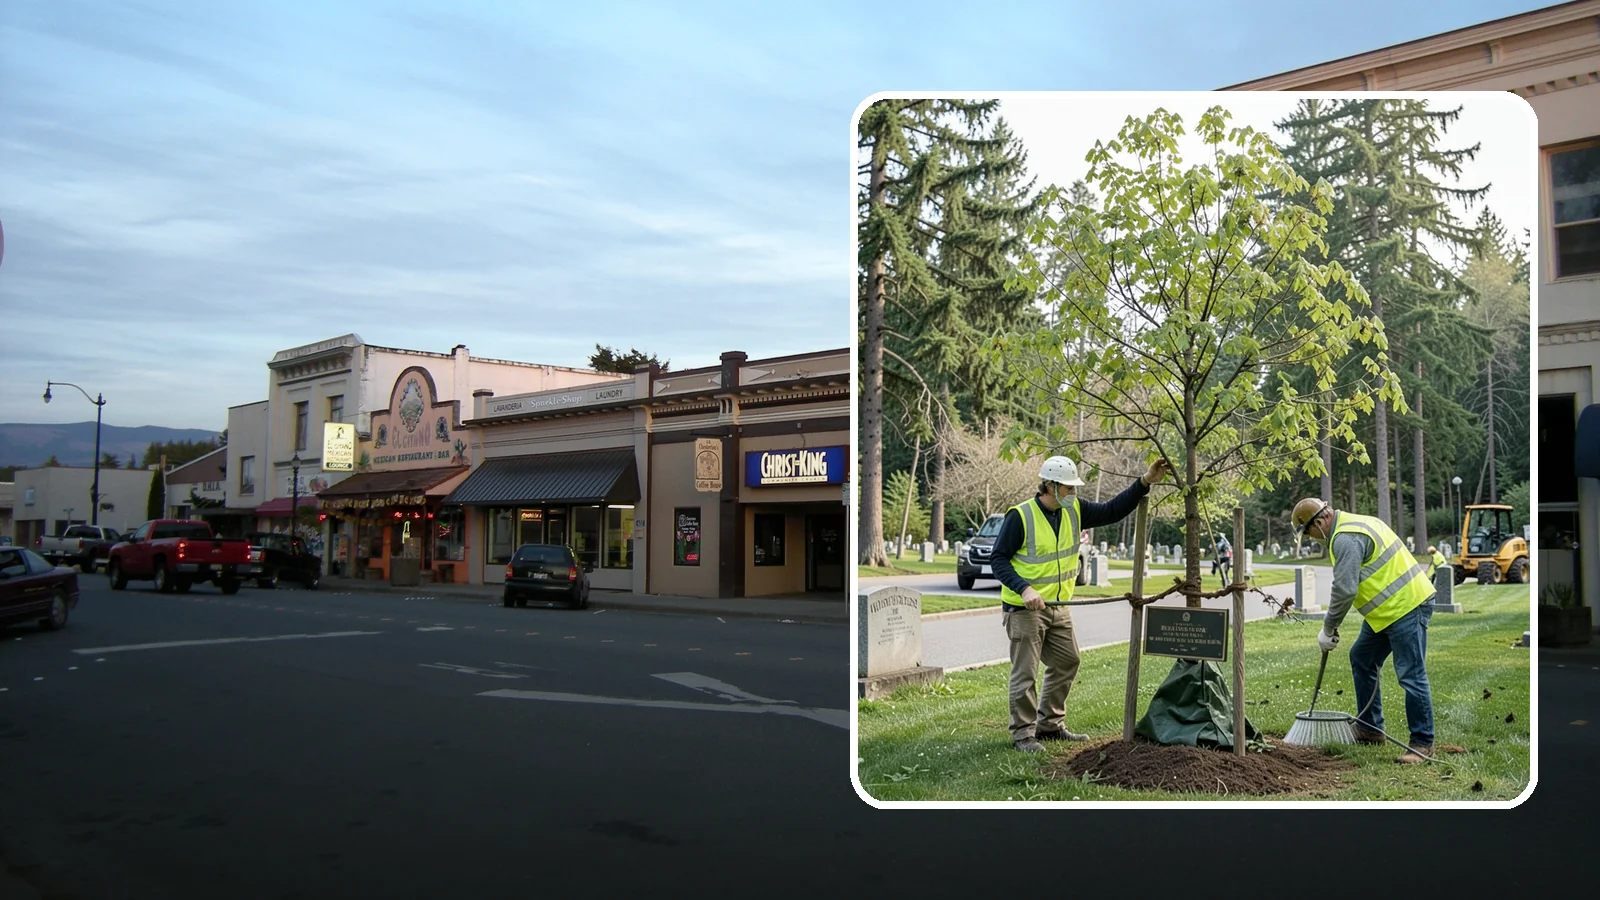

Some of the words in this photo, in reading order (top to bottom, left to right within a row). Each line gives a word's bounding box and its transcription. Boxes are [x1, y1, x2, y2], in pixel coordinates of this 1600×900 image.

[595, 389, 623, 400] LAUNDRY
[493, 402, 522, 412] LAVANDERIA
[373, 454, 396, 464] MEXICAN
[397, 451, 433, 462] RESTAURANT
[438, 450, 450, 458] BAR
[760, 452, 798, 477] CHRIST
[798, 450, 827, 477] KING
